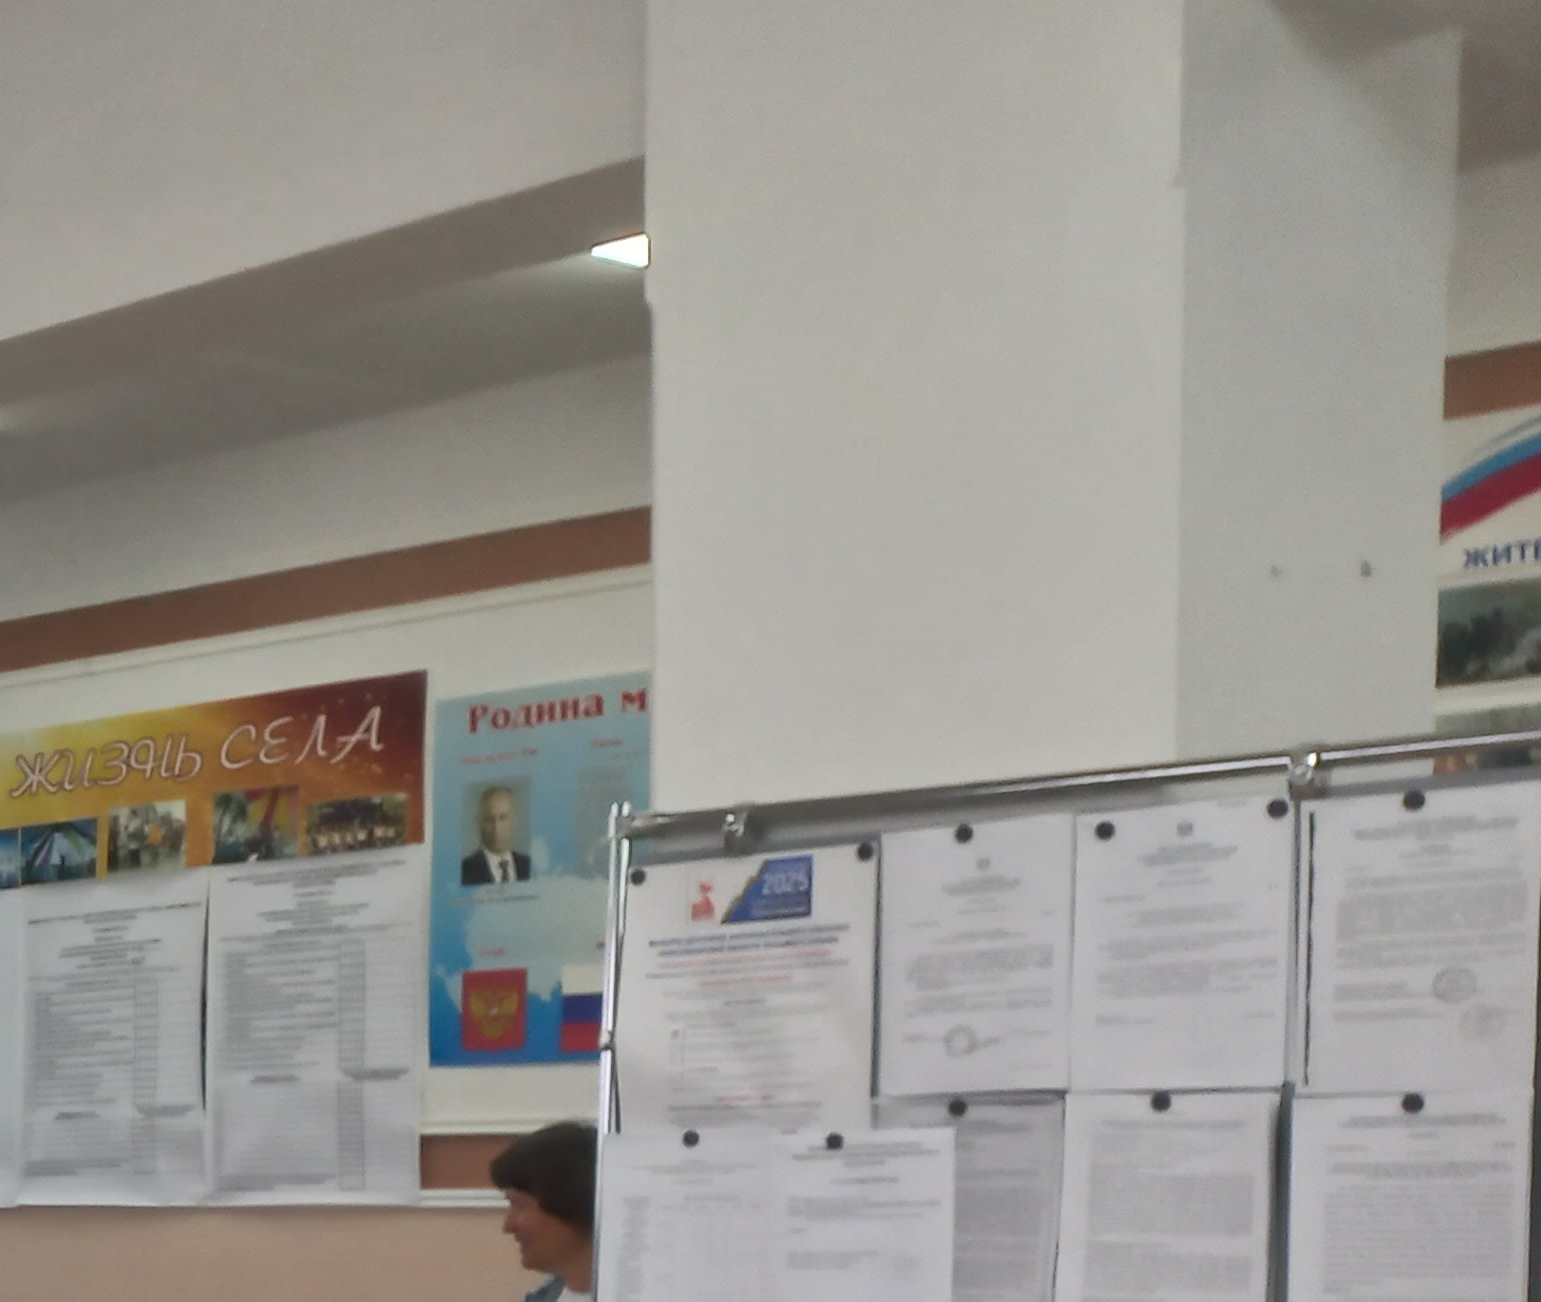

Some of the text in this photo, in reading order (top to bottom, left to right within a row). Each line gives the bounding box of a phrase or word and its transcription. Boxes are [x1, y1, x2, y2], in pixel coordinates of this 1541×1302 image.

[468, 693, 605, 735] Родина
[9, 733, 202, 798] ЖИЗНЬ
[221, 705, 385, 769] СЕЛА
